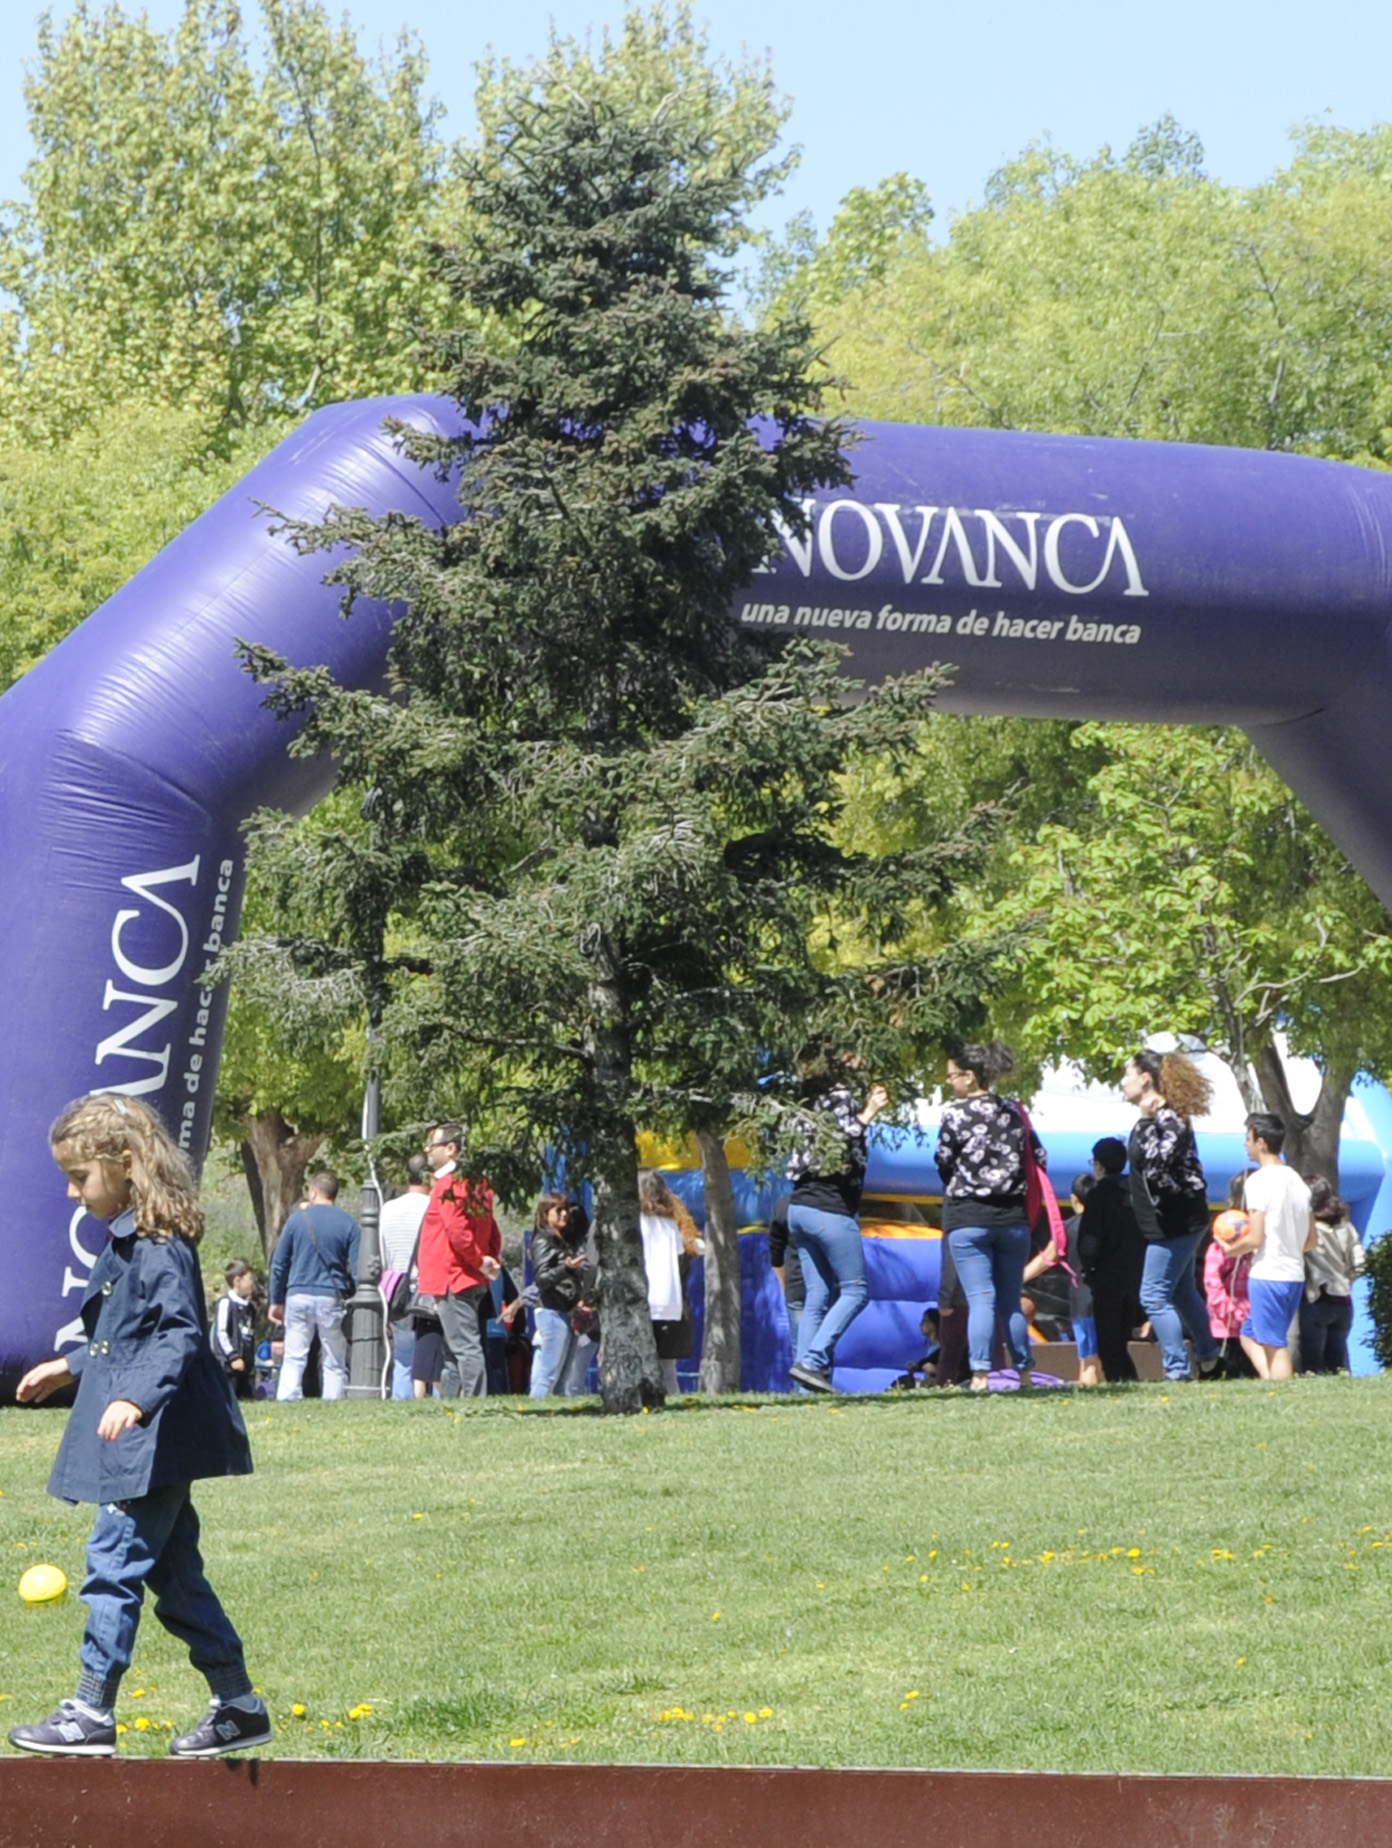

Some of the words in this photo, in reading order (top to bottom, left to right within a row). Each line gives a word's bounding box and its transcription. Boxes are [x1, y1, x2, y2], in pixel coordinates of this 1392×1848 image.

[750, 498, 1150, 597] NOVANCA
[740, 602, 791, 626] una
[793, 605, 873, 630] nueva
[875, 604, 953, 634] forma
[956, 608, 990, 636] de
[991, 610, 1065, 640] hacer
[1065, 614, 1142, 645] banca
[182, 1053, 204, 1094] de
[202, 858, 235, 953] banca
